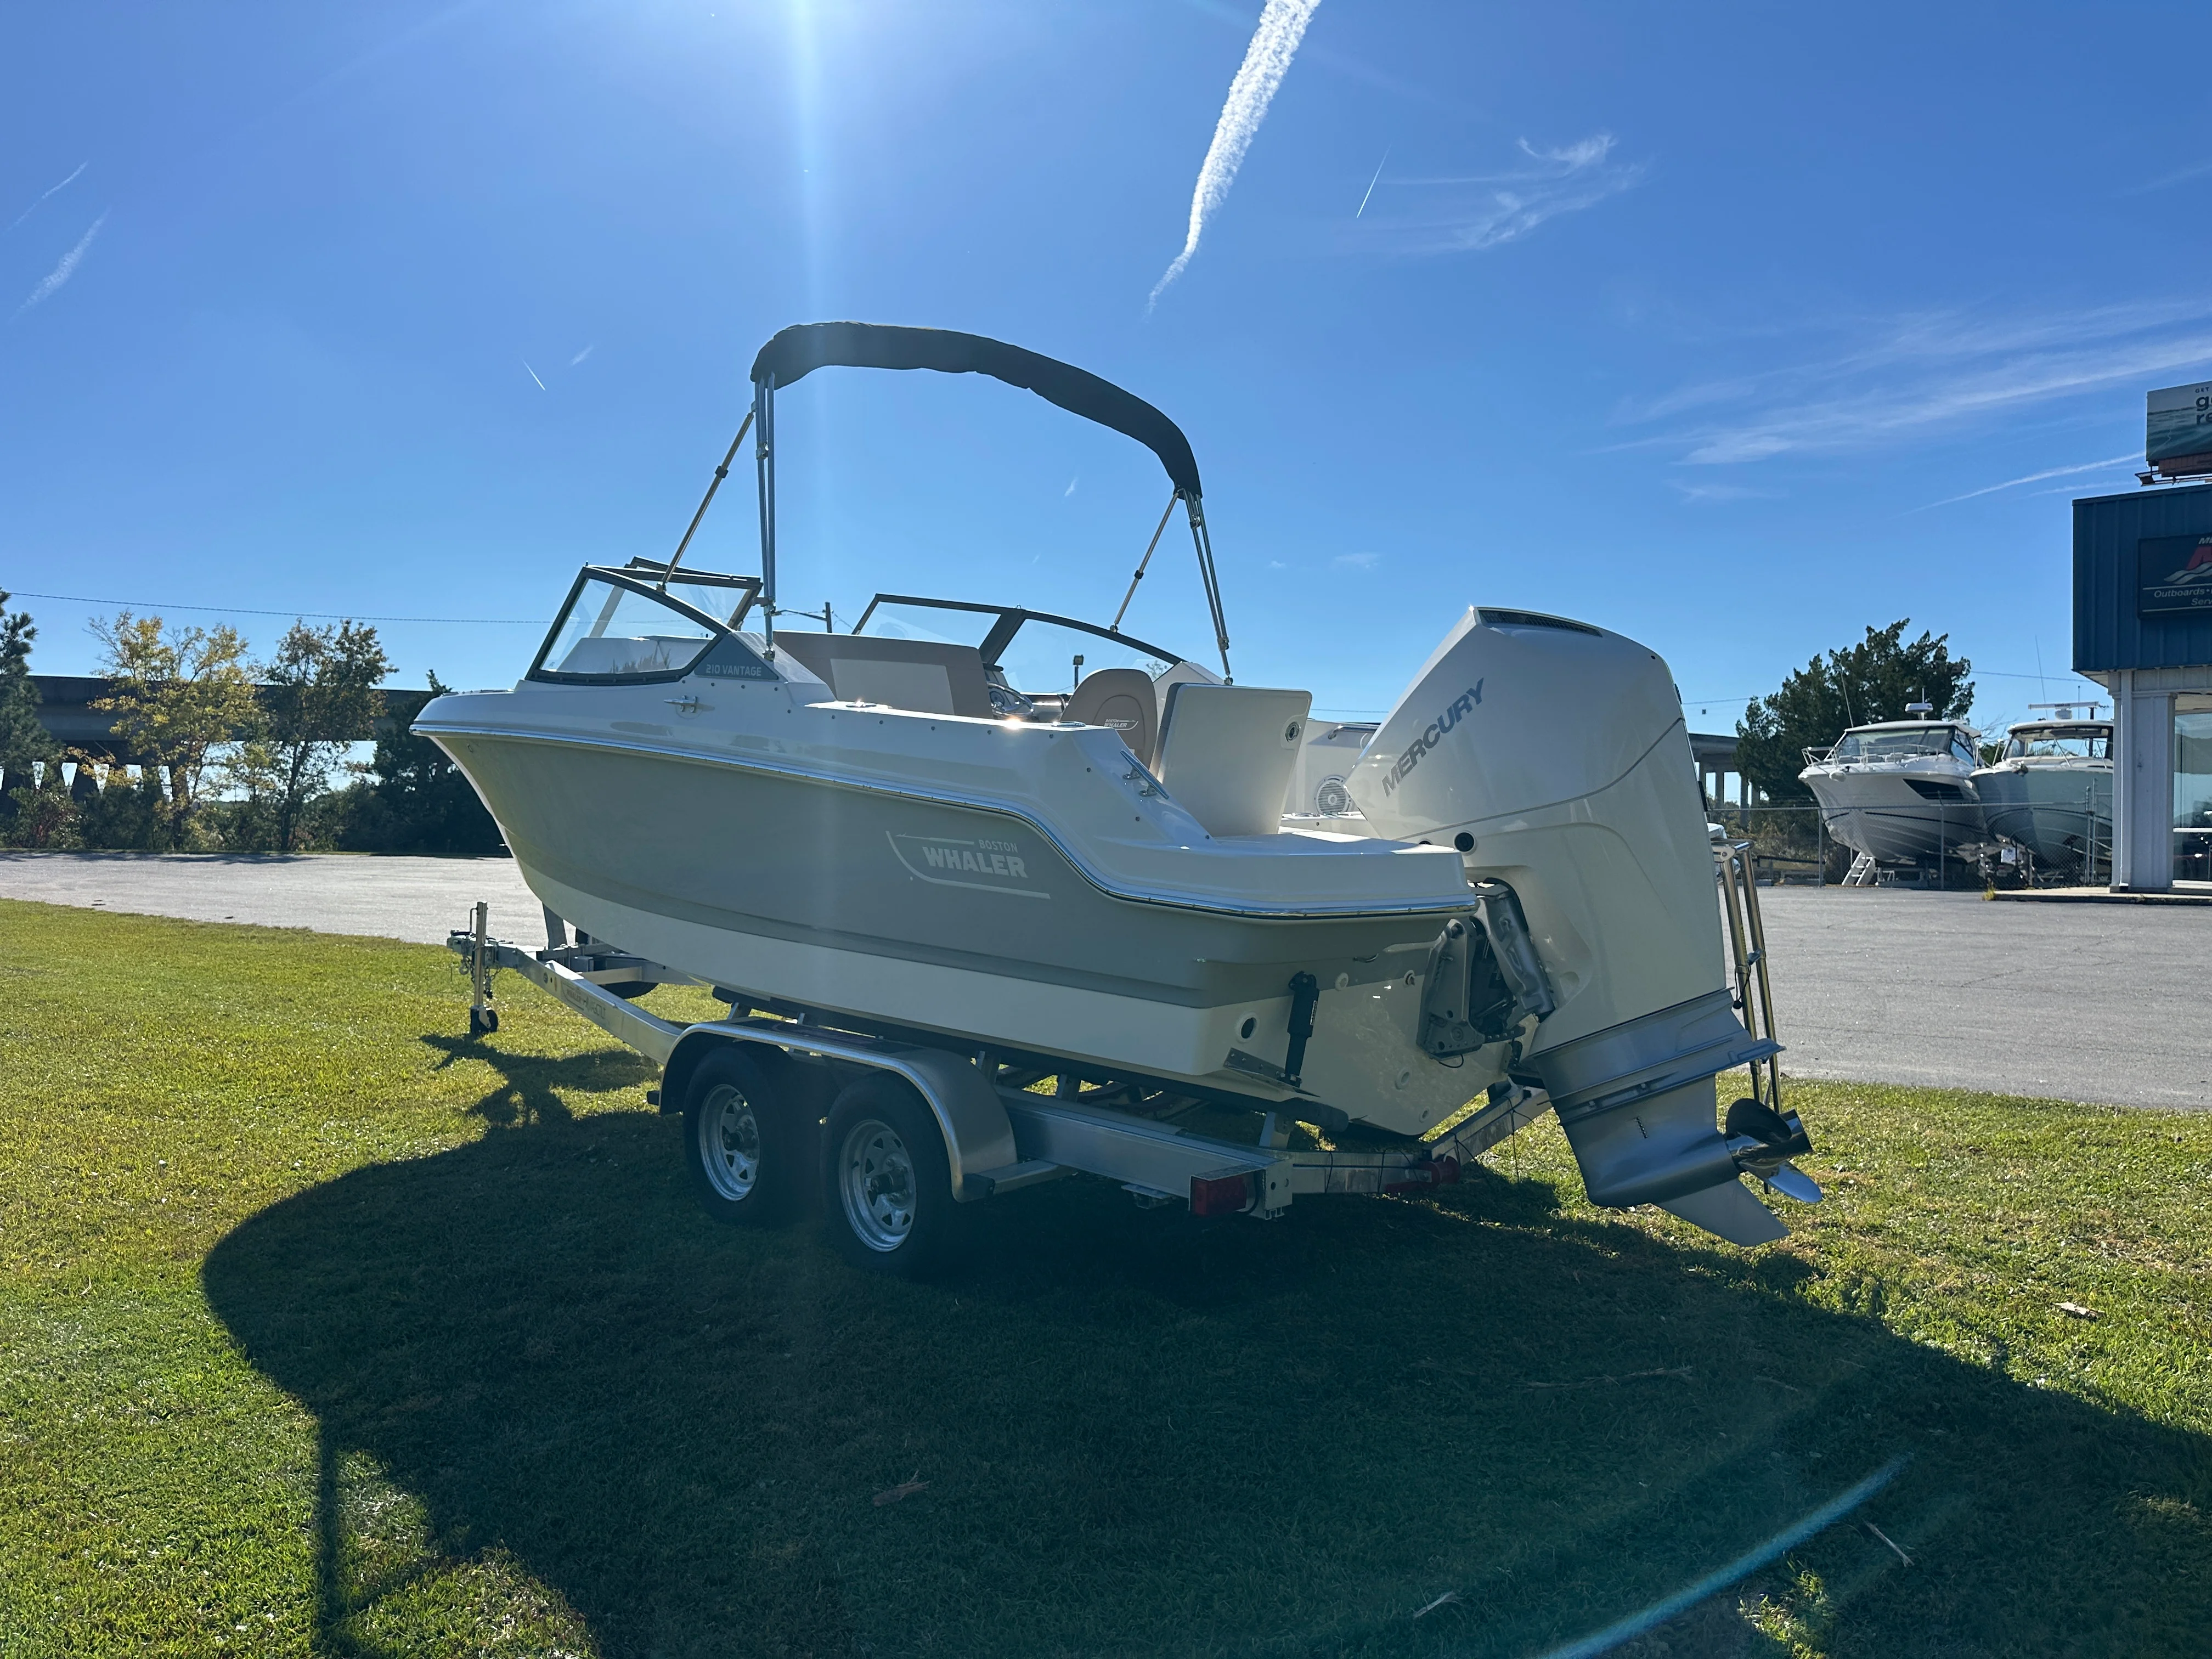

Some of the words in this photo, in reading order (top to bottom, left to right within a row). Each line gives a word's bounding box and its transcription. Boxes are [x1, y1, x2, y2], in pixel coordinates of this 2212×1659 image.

[706, 664, 720, 674] 210
[723, 665, 762, 676] VANTAGE
[1381, 677, 1484, 797] MERCURY
[978, 839, 1018, 853] BOSTON
[922, 847, 1028, 878] WHALER
